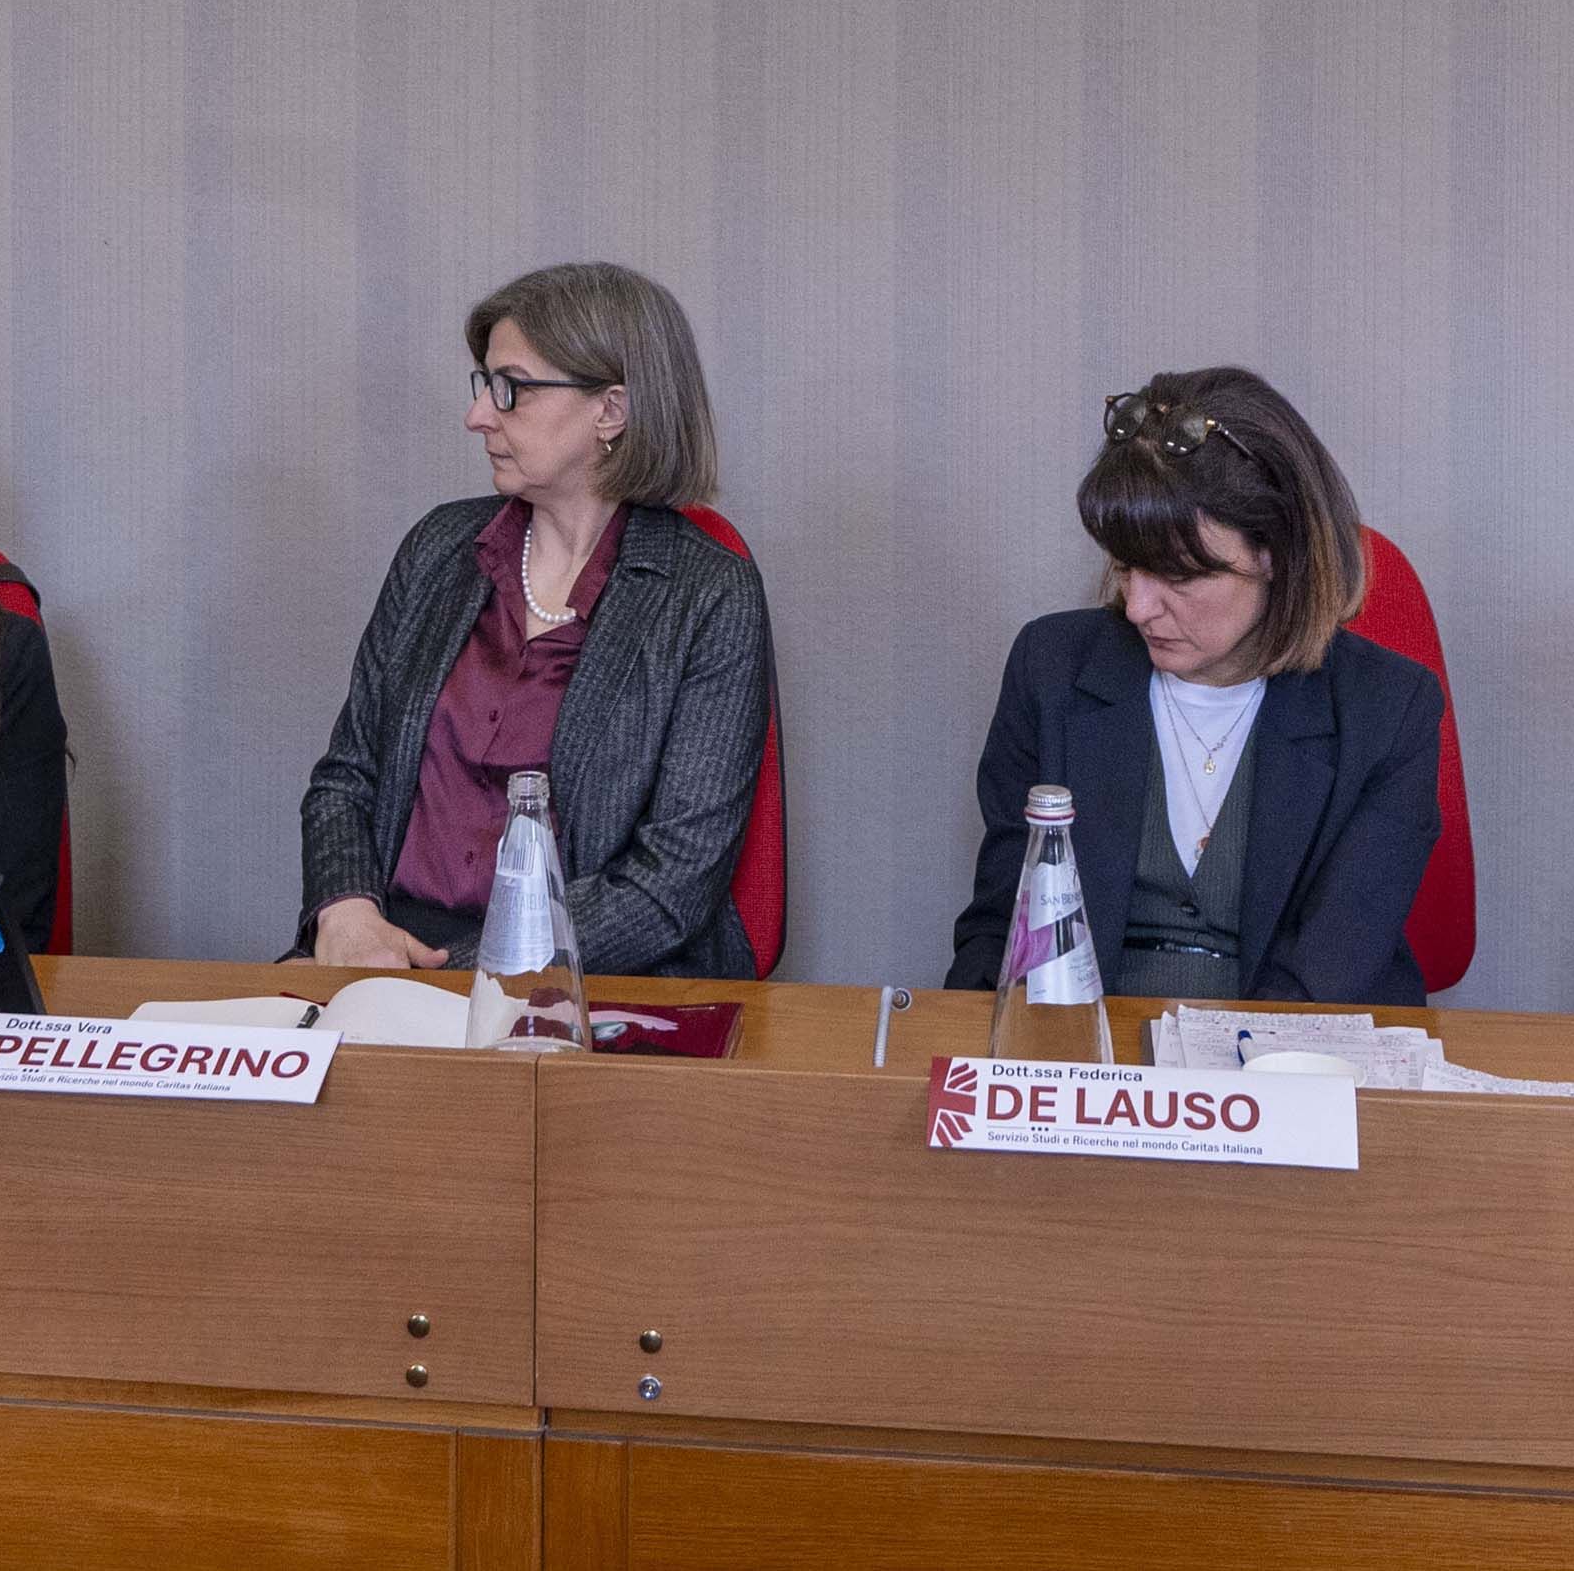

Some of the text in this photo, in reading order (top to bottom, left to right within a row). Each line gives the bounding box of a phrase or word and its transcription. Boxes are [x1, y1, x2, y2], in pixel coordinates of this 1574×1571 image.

[6, 1017, 112, 1035] Dott.ssa Vera
[992, 1064, 1143, 1082] Dott.ssa Federica
[22, 1074, 47, 1084] Studi
[57, 1075, 100, 1086] Ricerche
[102, 1078, 118, 1087] nel
[119, 1079, 153, 1089] mondo
[156, 1080, 191, 1090] Caritas
[193, 1082, 231, 1093] Italiana
[986, 1083, 1261, 1133] DE LAUSO
[988, 1131, 1263, 1155] Servizio Studi e Ricerche nel mondo Caritas Italiana
